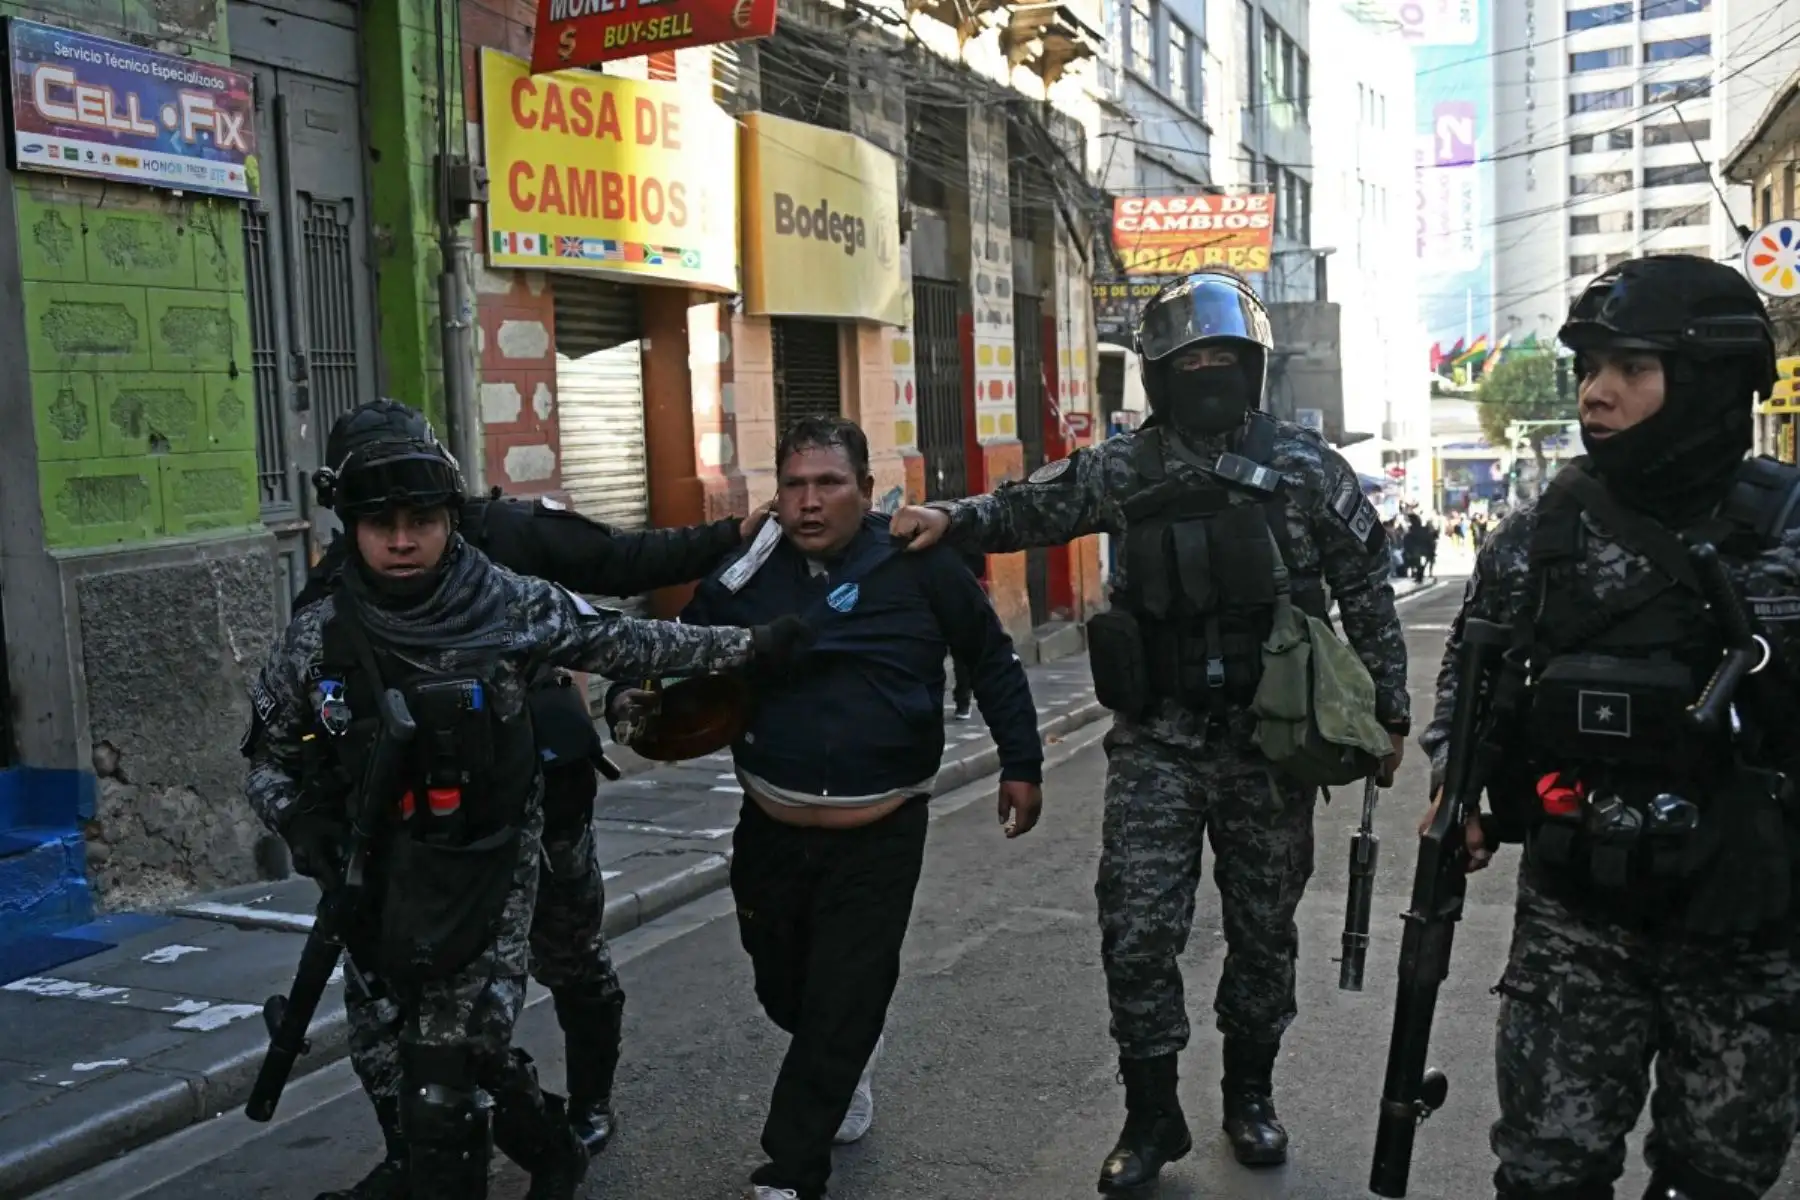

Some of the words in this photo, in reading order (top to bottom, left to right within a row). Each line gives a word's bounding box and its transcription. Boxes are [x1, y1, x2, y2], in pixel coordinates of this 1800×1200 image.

[604, 12, 694, 48] BUY-SELL
[54, 41, 102, 64] Servicio
[105, 51, 149, 74] Técnico
[152, 62, 225, 90] Especializado
[35, 65, 157, 135] CELL
[181, 92, 247, 151] FIX
[511, 76, 623, 142] CASA
[635, 96, 682, 150] DE
[143, 159, 182, 175] HONOR
[508, 160, 688, 227] CAMBIOS
[1120, 196, 1212, 214] CASA
[1220, 195, 1269, 213] DE
[773, 191, 866, 256] Bodega
[1115, 213, 1270, 231] CAMBIOS
[1110, 285, 1128, 297] DE
